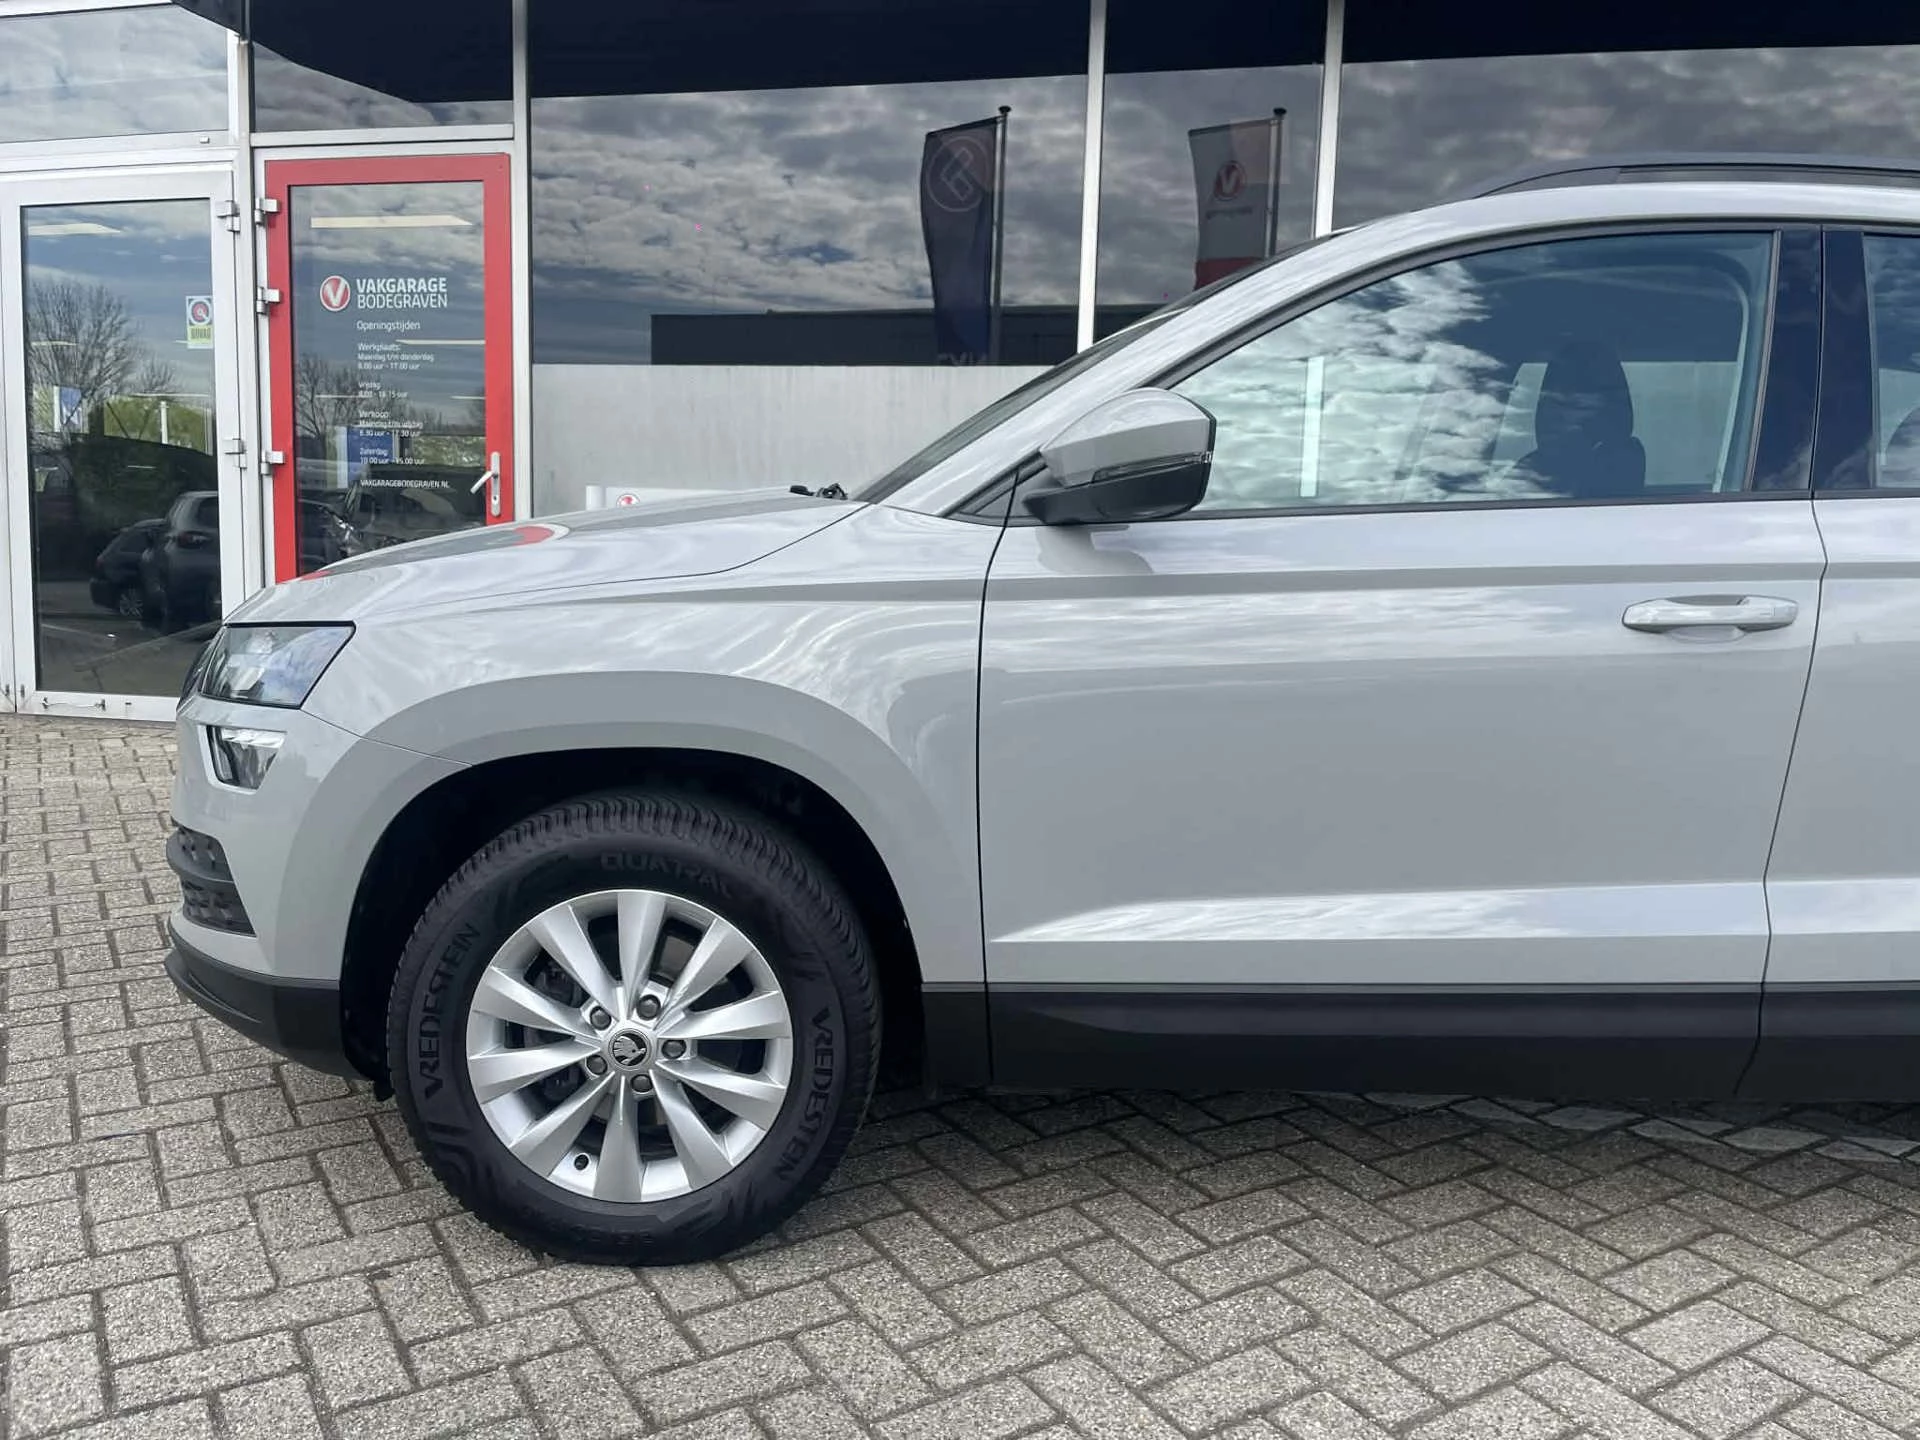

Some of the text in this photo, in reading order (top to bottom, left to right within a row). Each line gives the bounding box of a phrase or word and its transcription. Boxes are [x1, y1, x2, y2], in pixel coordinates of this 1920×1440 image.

[356, 278, 447, 293] VAKGARAGE
[357, 294, 448, 309] BODEGRAVEN
[356, 320, 421, 333] Openingstijden
[358, 353, 386, 362] Maandag
[419, 923, 481, 1098] VREDESTEIN
[774, 1007, 834, 1182] VREDESTEIN
